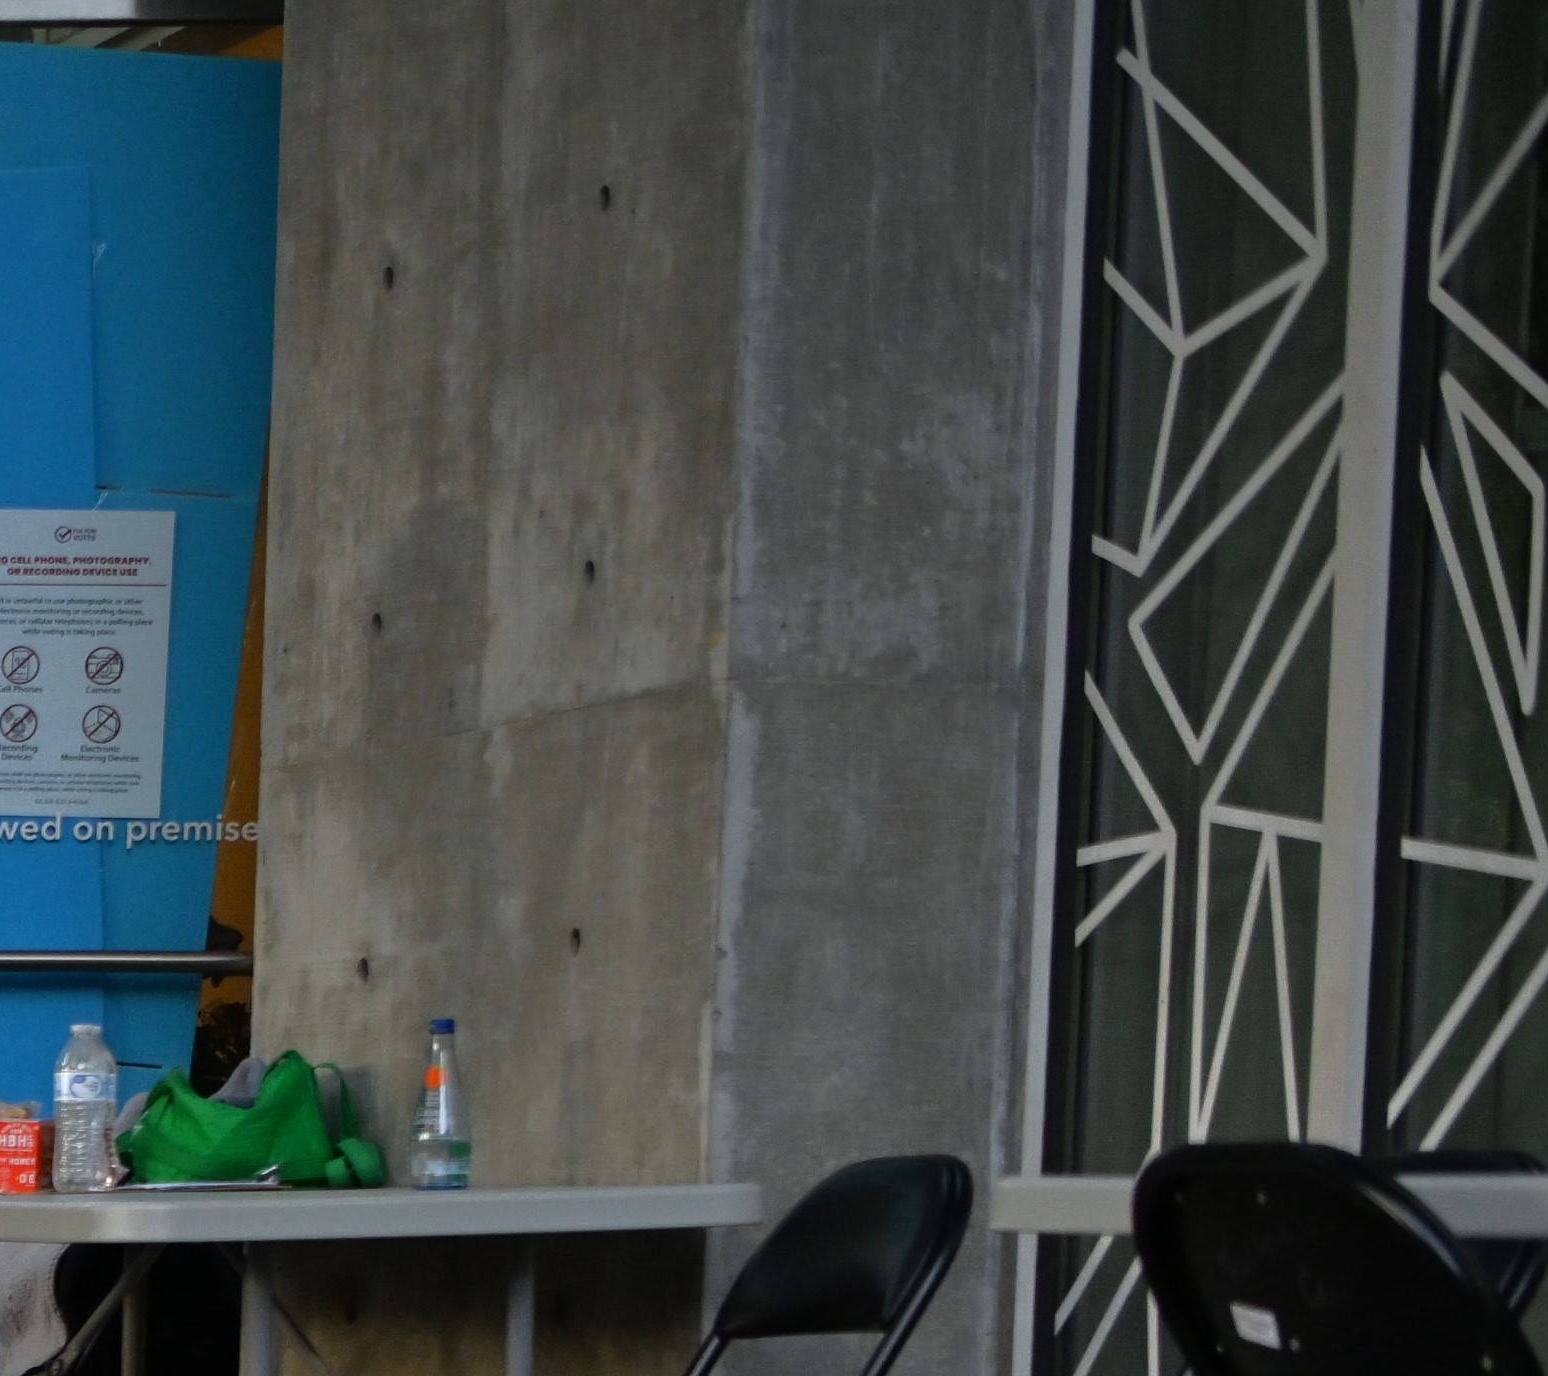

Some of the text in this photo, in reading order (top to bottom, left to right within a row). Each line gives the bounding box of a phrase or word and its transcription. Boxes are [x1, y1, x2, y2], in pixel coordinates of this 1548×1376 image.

[10, 556, 32, 565] CELL
[34, 556, 71, 565] PHONE,
[7, 568, 138, 577] OR RECORDING DEVICE USE
[12, 685, 43, 694] Phones
[85, 686, 121, 694] Cameras
[80, 745, 121, 753] Electronic
[1, 753, 33, 761] Devices
[61, 754, 139, 764] Monitoring Devices
[73, 818, 115, 842] on
[126, 812, 259, 850] premise
